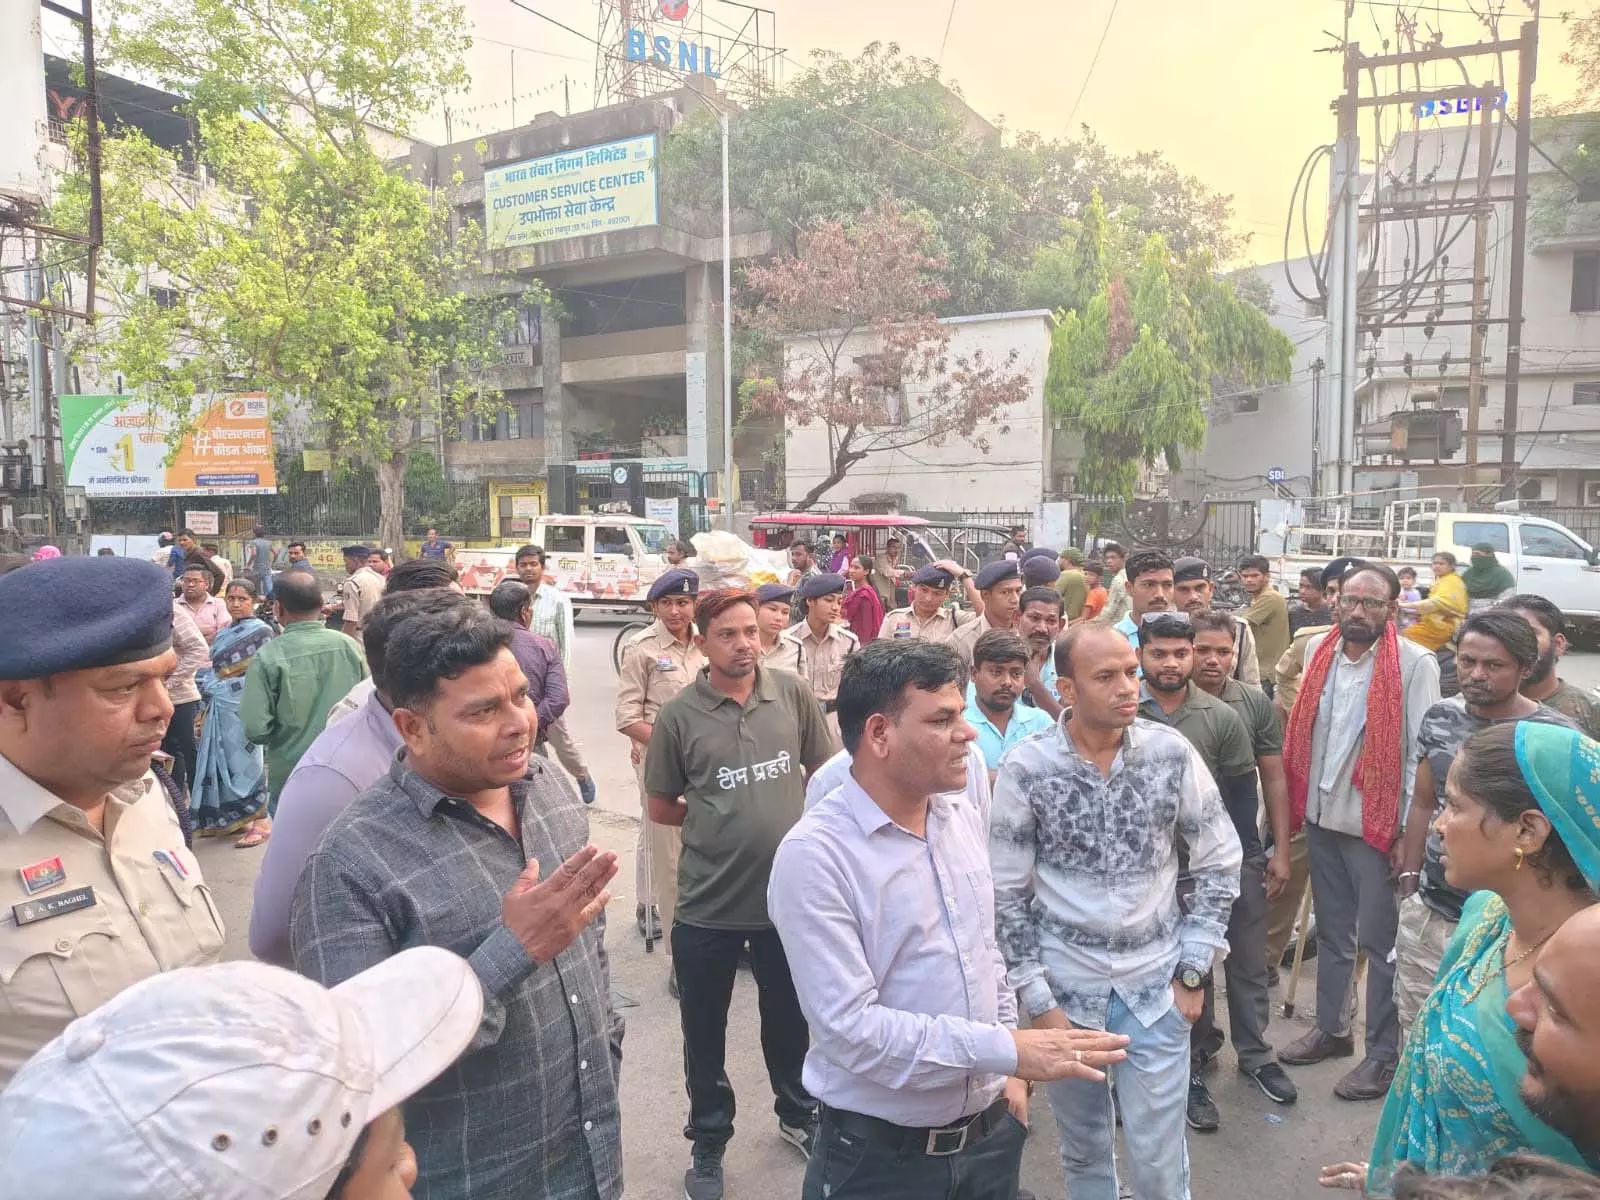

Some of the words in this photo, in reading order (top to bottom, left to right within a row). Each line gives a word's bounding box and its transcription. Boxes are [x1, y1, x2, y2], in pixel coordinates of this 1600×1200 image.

[626, 28, 720, 79] BSNL
[504, 168, 528, 184] भारत
[529, 161, 554, 178] संचार
[555, 156, 584, 173] निगम
[586, 146, 628, 167] लिमिटेड
[493, 189, 549, 210] CUSTOMER
[550, 179, 596, 200] SERVICE
[598, 170, 646, 191] CENTER
[519, 204, 562, 226] उपभोक्ता
[564, 199, 587, 218] सेवा
[589, 196, 616, 213] केन्द्र
[1269, 470, 1285, 480] SBI
[716, 766, 748, 790] टीम
[751, 750, 791, 782] प्रहरी
